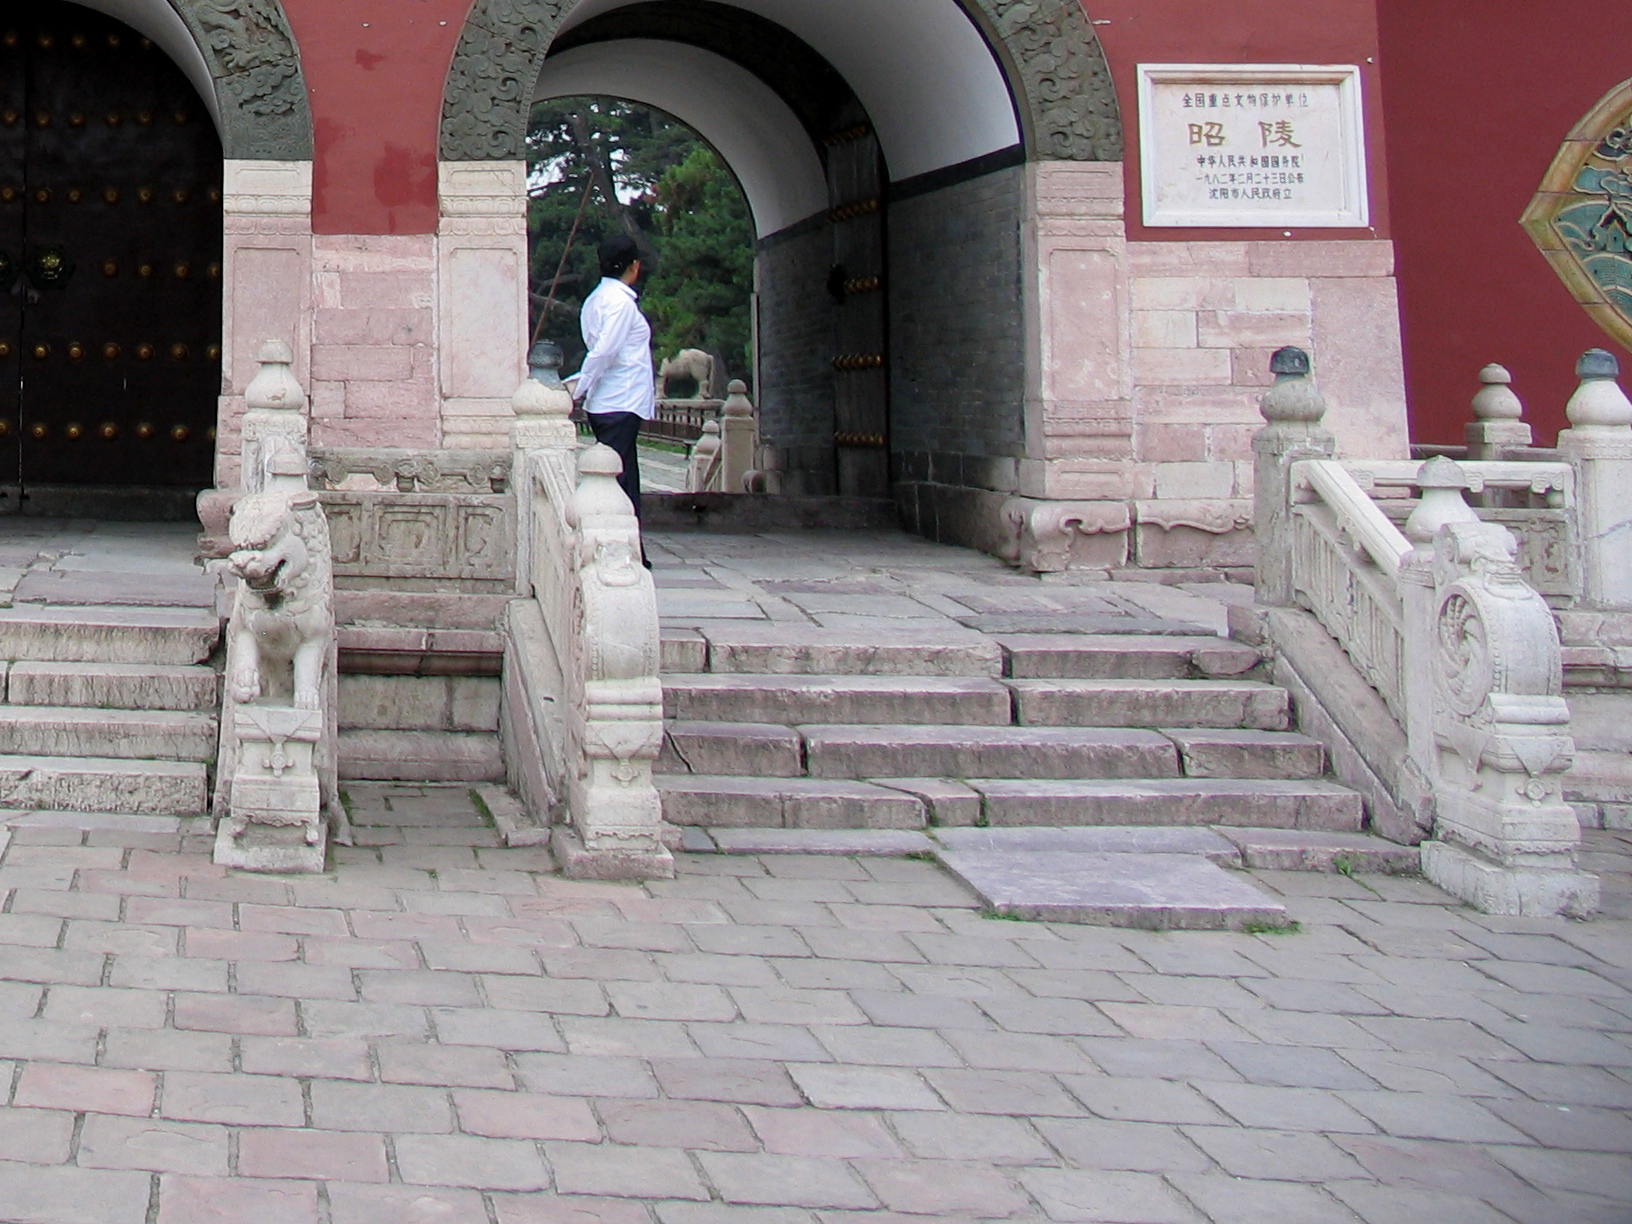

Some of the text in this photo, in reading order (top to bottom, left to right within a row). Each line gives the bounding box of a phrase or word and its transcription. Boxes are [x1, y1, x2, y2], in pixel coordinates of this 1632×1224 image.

[1182, 92, 1308, 108] 全国重点文物保护单位
[1188, 120, 1302, 149] 昭陵
[1196, 154, 1301, 169] 中华人民共和国国务院
[1195, 172, 1304, 185] 一九八二年二月二十三日公布
[1208, 187, 1293, 200] 沈阳市人民政府立
